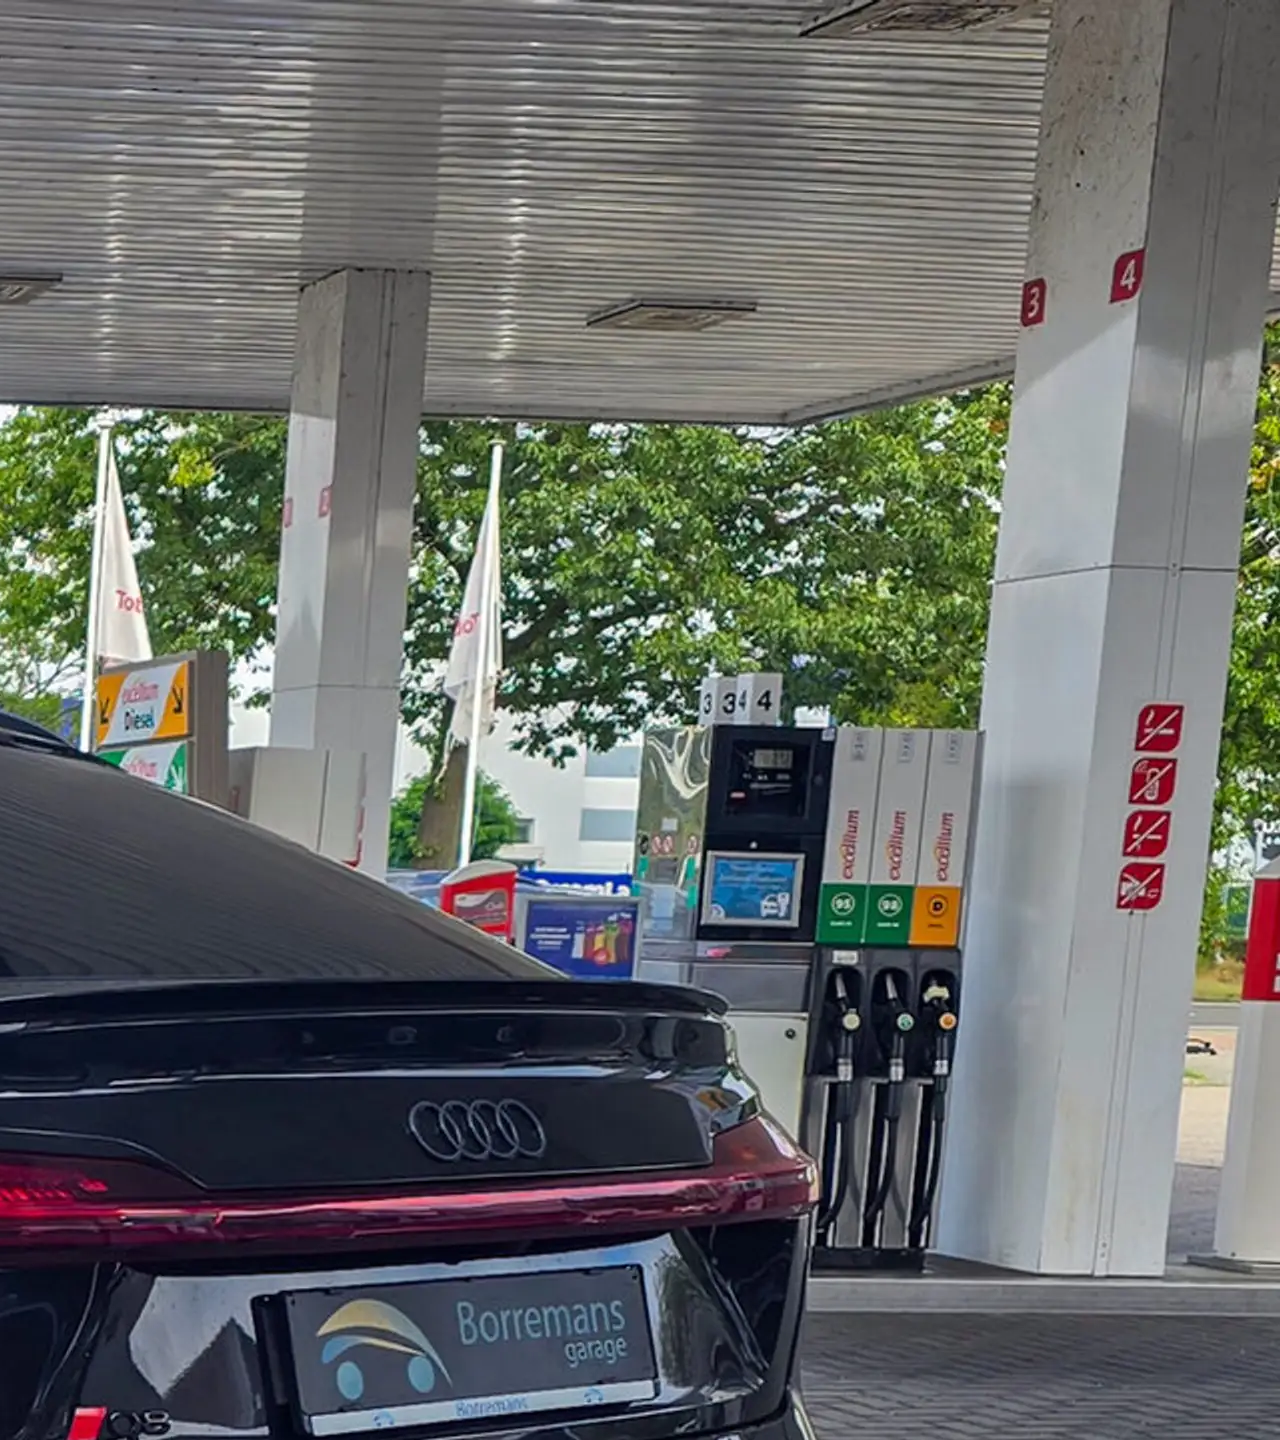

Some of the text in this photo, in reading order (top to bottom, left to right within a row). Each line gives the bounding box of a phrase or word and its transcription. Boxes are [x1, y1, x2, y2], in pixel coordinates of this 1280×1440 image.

[1120, 259, 1136, 291] 4
[1027, 286, 1040, 318] 3
[704, 693, 713, 715] 3
[722, 692, 737, 714] 3
[757, 690, 772, 711] 4
[457, 1300, 626, 1345] Borremans
[564, 1337, 628, 1368] garage
